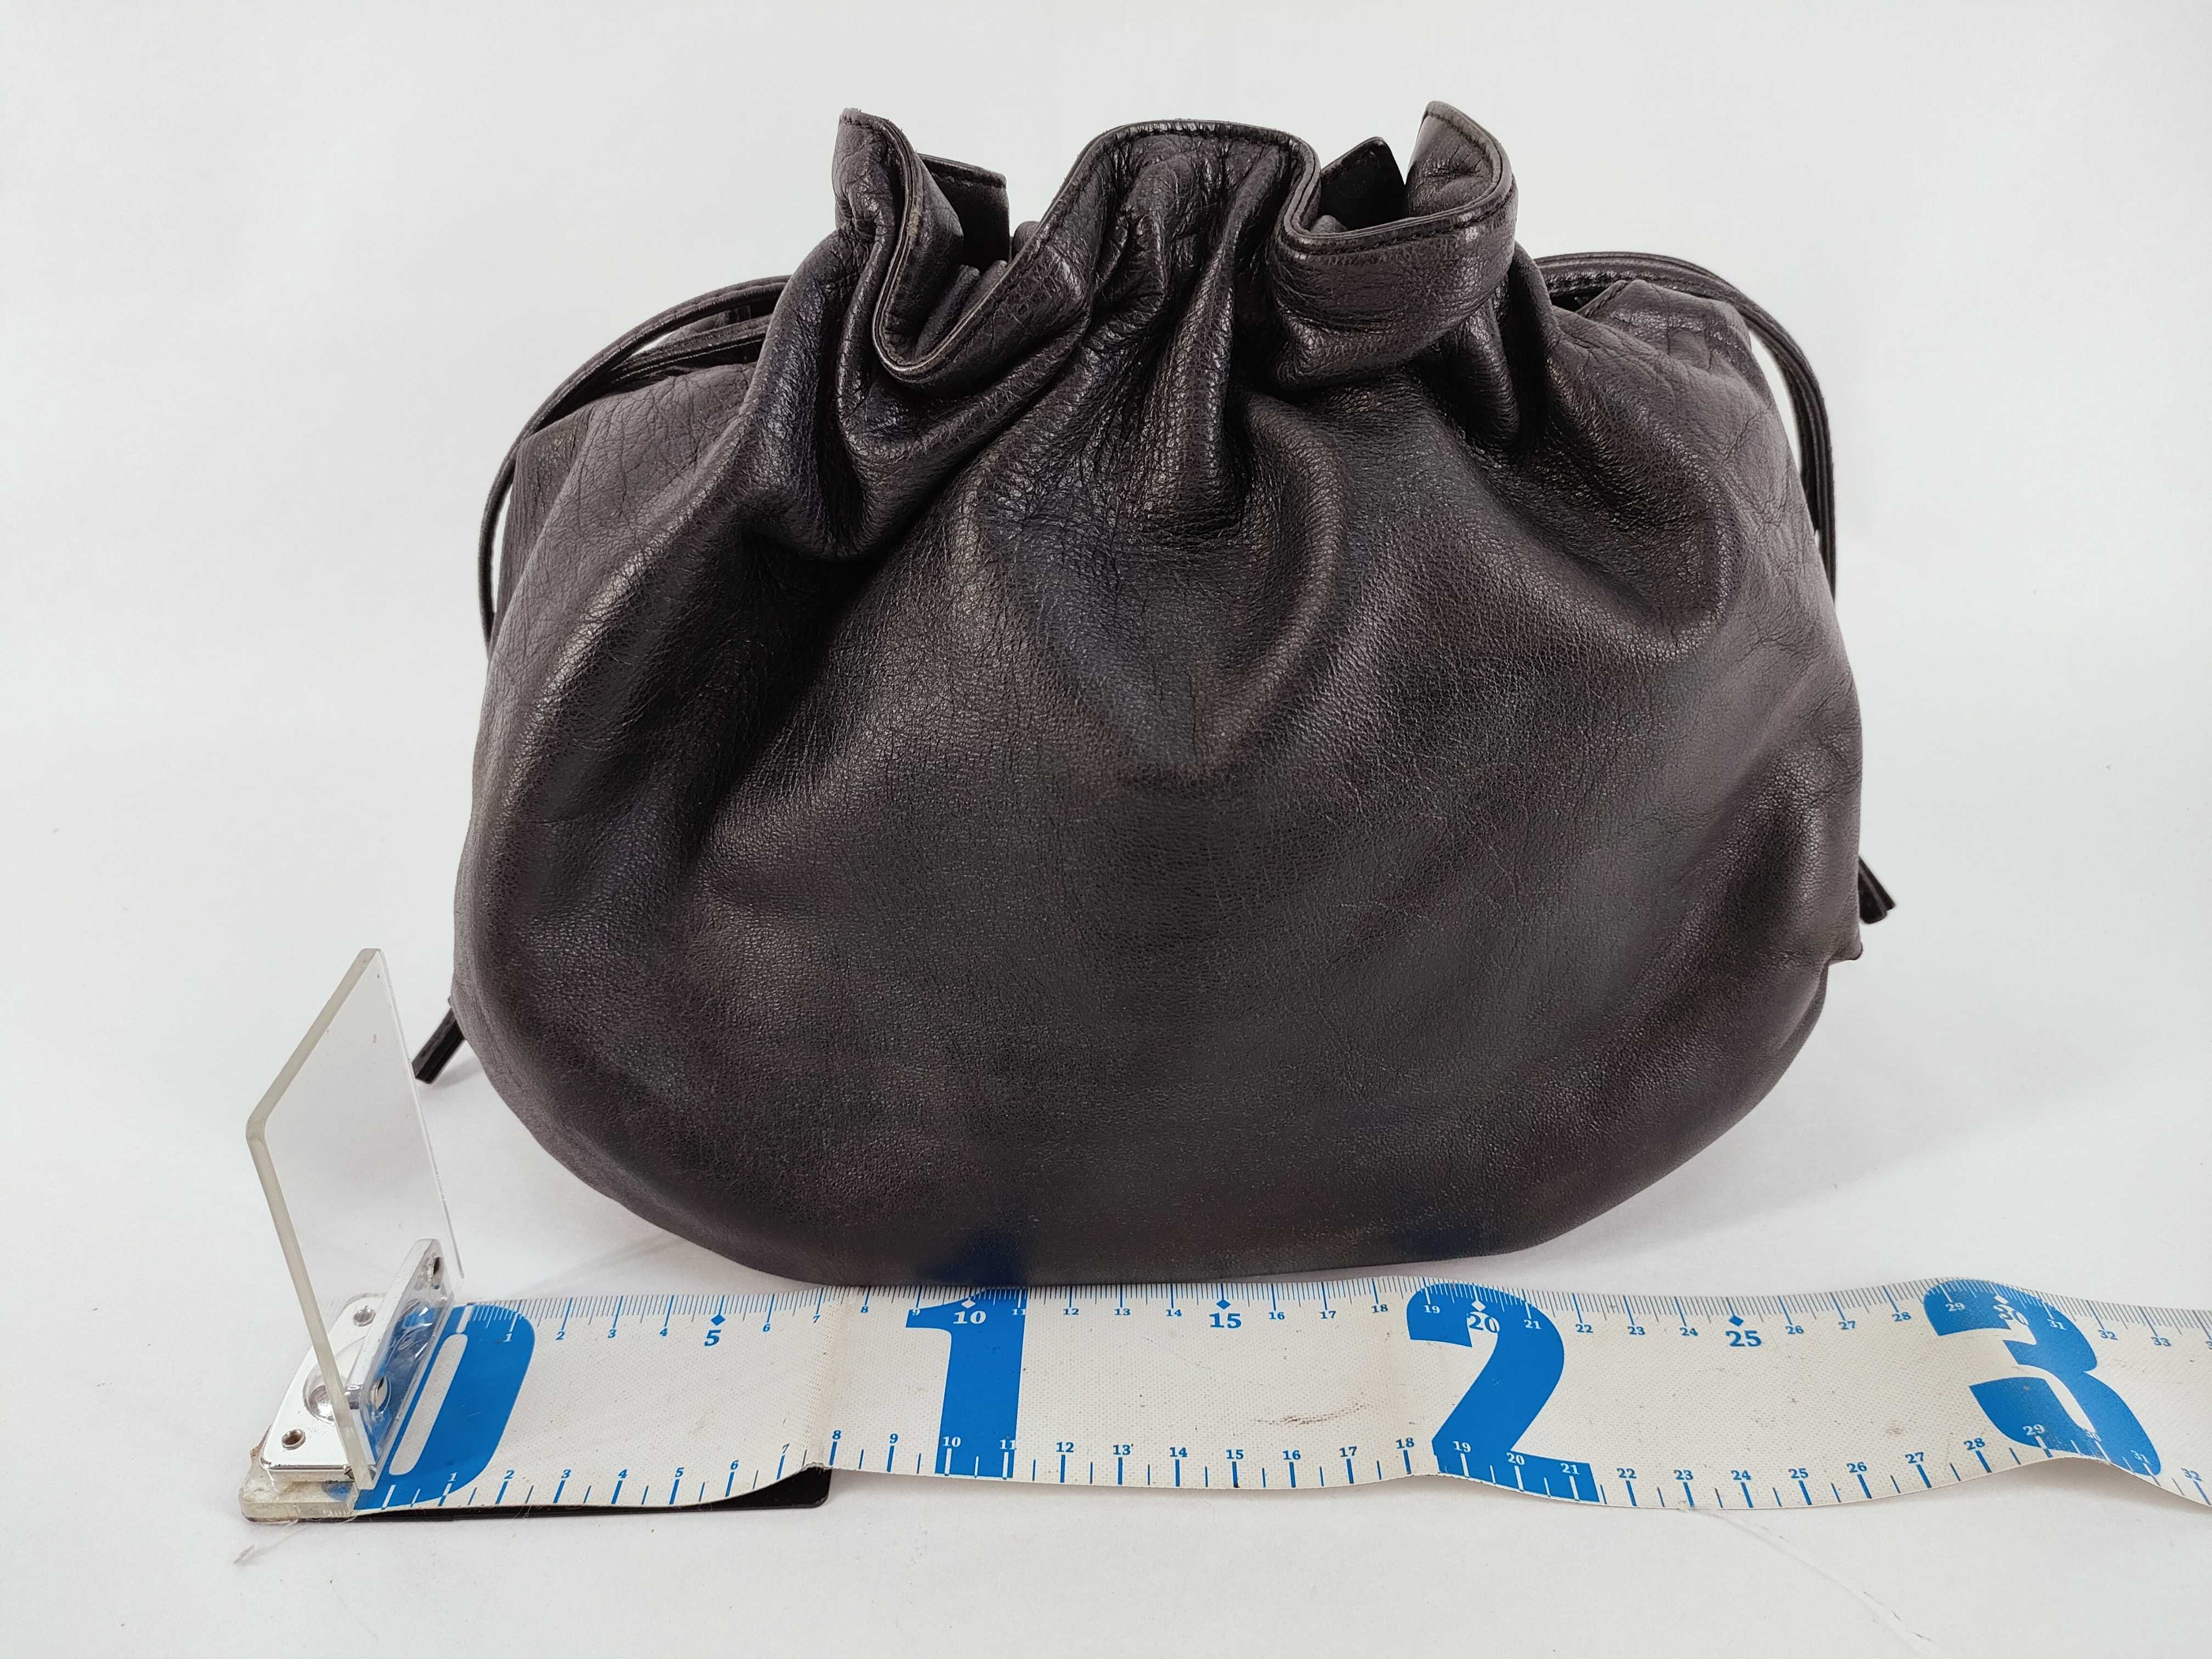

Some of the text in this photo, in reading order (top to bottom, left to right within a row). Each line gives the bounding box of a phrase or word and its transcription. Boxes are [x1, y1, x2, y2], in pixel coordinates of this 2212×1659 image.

[503, 1332, 514, 1342] 1
[556, 1331, 566, 1340] 2
[607, 1329, 617, 1339] 3
[660, 1328, 668, 1336] 4
[704, 1329, 721, 1346] 5
[763, 1324, 771, 1332] 6
[813, 1315, 820, 1323] 7
[952, 1311, 986, 1324] 10
[1209, 1313, 1242, 1328] 15
[1320, 1311, 1336, 1319] 17
[1372, 1305, 1388, 1313] 18
[1423, 1305, 1440, 1314] 19
[1468, 1311, 1500, 1333] 20
[1523, 1319, 1542, 1329] 21
[1576, 1324, 1593, 1333] 22
[1627, 1326, 1645, 1335] 23
[1679, 1328, 1698, 1336] 24
[1725, 1330, 1762, 1347] 25
[1785, 1325, 1804, 1335] 26
[1838, 1321, 1856, 1330] 27
[1892, 1312, 1911, 1322] 28
[1945, 1302, 1965, 1312] 29
[1993, 1305, 2029, 1326] 30
[2047, 1319, 2067, 1330] 31
[2098, 1329, 2118, 1340] 32
[2151, 1336, 2171, 1346] 33
[905, 1289, 1026, 1478] 1
[1406, 1283, 1600, 1503] 2
[1923, 1279, 2162, 1476] 3
[448, 1473, 457, 1481] 1
[506, 1470, 515, 1479] 2
[561, 1470, 571, 1479] 3
[618, 1469, 627, 1479] 4
[675, 1468, 684, 1477] 5
[730, 1460, 739, 1470] 6
[782, 1444, 789, 1454] 7
[832, 1430, 841, 1440] 8
[889, 1434, 898, 1443] 9
[943, 1436, 961, 1447] 10
[1000, 1440, 1017, 1449] 11
[1056, 1442, 1074, 1453] 12
[1113, 1444, 1131, 1455] 13
[1169, 1447, 1187, 1457] 14
[1226, 1449, 1244, 1459] 15
[1283, 1450, 1301, 1460] 16
[1339, 1446, 1357, 1457] 17
[1396, 1438, 1414, 1449] 18
[1453, 1441, 1471, 1453] 19
[1506, 1453, 1525, 1465] 20
[1560, 1463, 1580, 1475] 21
[1617, 1468, 1637, 1479] 22
[1673, 1469, 1694, 1480] 23
[1731, 1470, 1751, 1480] 24
[1788, 1468, 1809, 1479] 25
[1846, 1462, 1867, 1472] 26
[1905, 1452, 1924, 1464] 27
[1963, 1438, 1985, 1451] 28
[2023, 1424, 2045, 1436] 29
[2130, 1449, 2151, 1465] 31
[2181, 1468, 2203, 1481] 32
